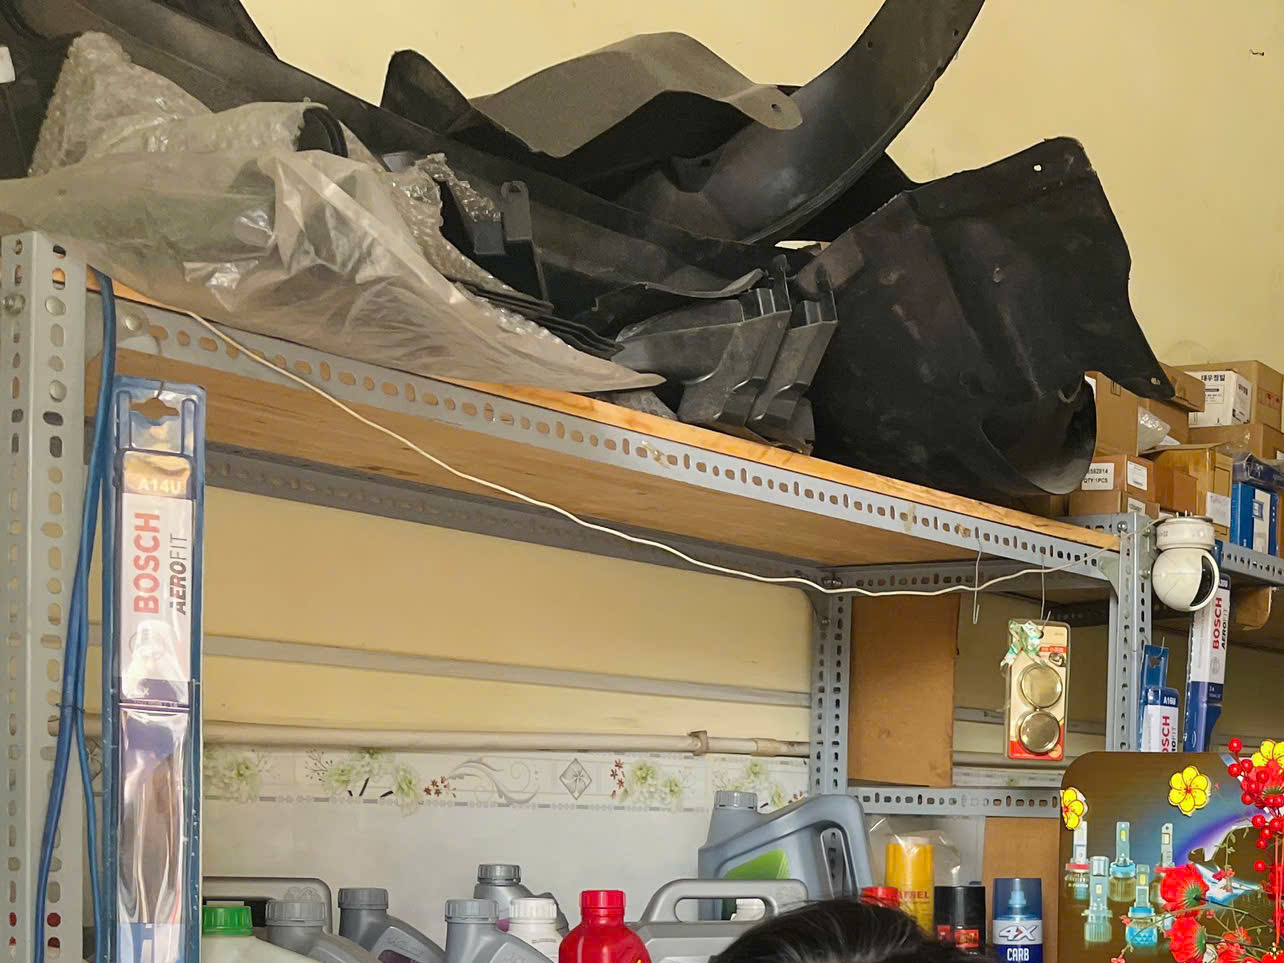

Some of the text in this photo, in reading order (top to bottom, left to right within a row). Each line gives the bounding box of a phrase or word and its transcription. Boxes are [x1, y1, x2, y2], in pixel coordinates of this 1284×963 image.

[133, 511, 161, 615] BOSCH
[1212, 597, 1223, 650] BOSCH
[1161, 715, 1171, 753] OSCH
[1006, 947, 1031, 962] CARB
